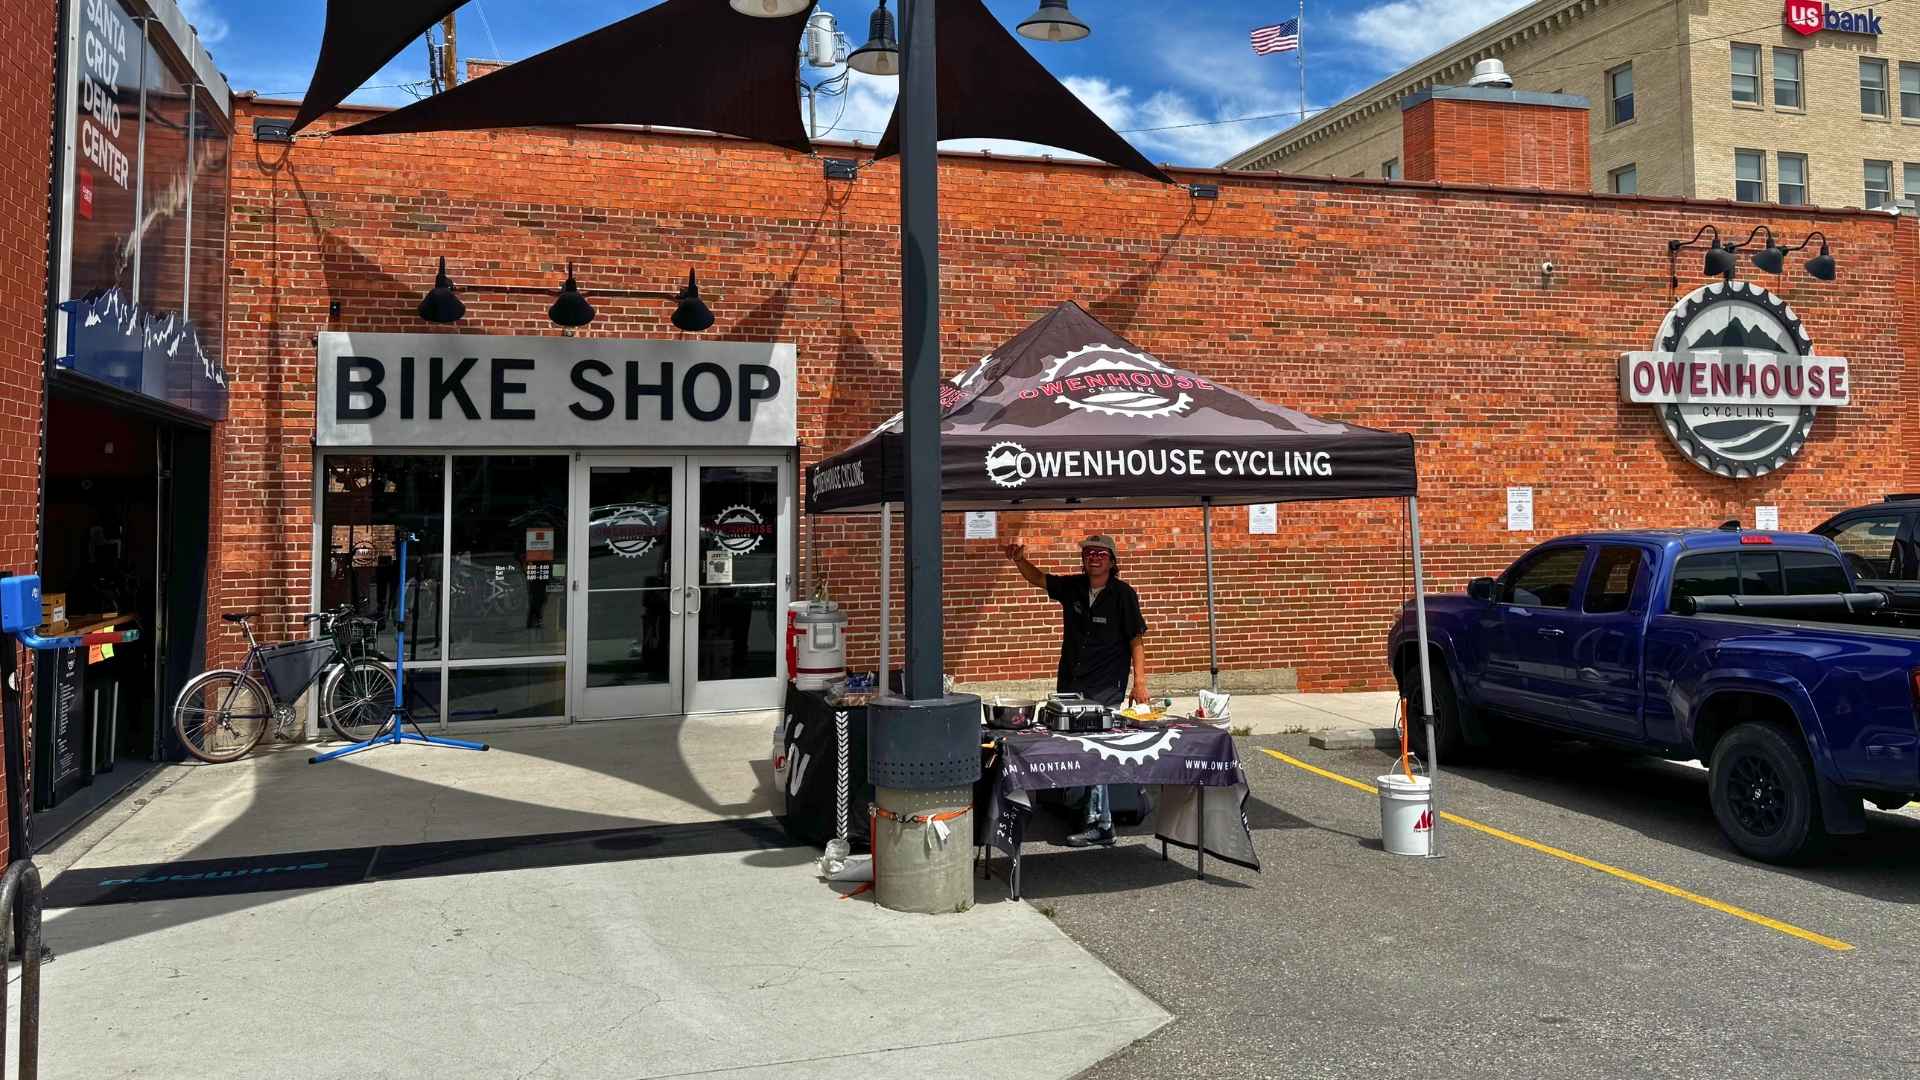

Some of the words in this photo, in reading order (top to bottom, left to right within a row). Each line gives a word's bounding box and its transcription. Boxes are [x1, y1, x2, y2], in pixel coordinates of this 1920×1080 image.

[87, 0, 126, 61] SANTA
[1791, 5, 1818, 27] us
[1824, 3, 1882, 35] bank
[85, 30, 119, 95] CRUZ
[84, 72, 120, 138] DEMO
[82, 119, 129, 190] CENTER
[336, 355, 536, 420] BIKE
[568, 359, 781, 422] SHOP
[1019, 371, 1215, 401] OWENHOUSE
[1088, 386, 1155, 394] CYCLING
[1633, 360, 1847, 399] OWENHOUSE
[1702, 406, 1775, 417] CYCLING
[1016, 449, 1206, 479] OWENHOUSE
[1214, 450, 1333, 476] CYCLING
[1030, 760, 1081, 773] MONTANA
